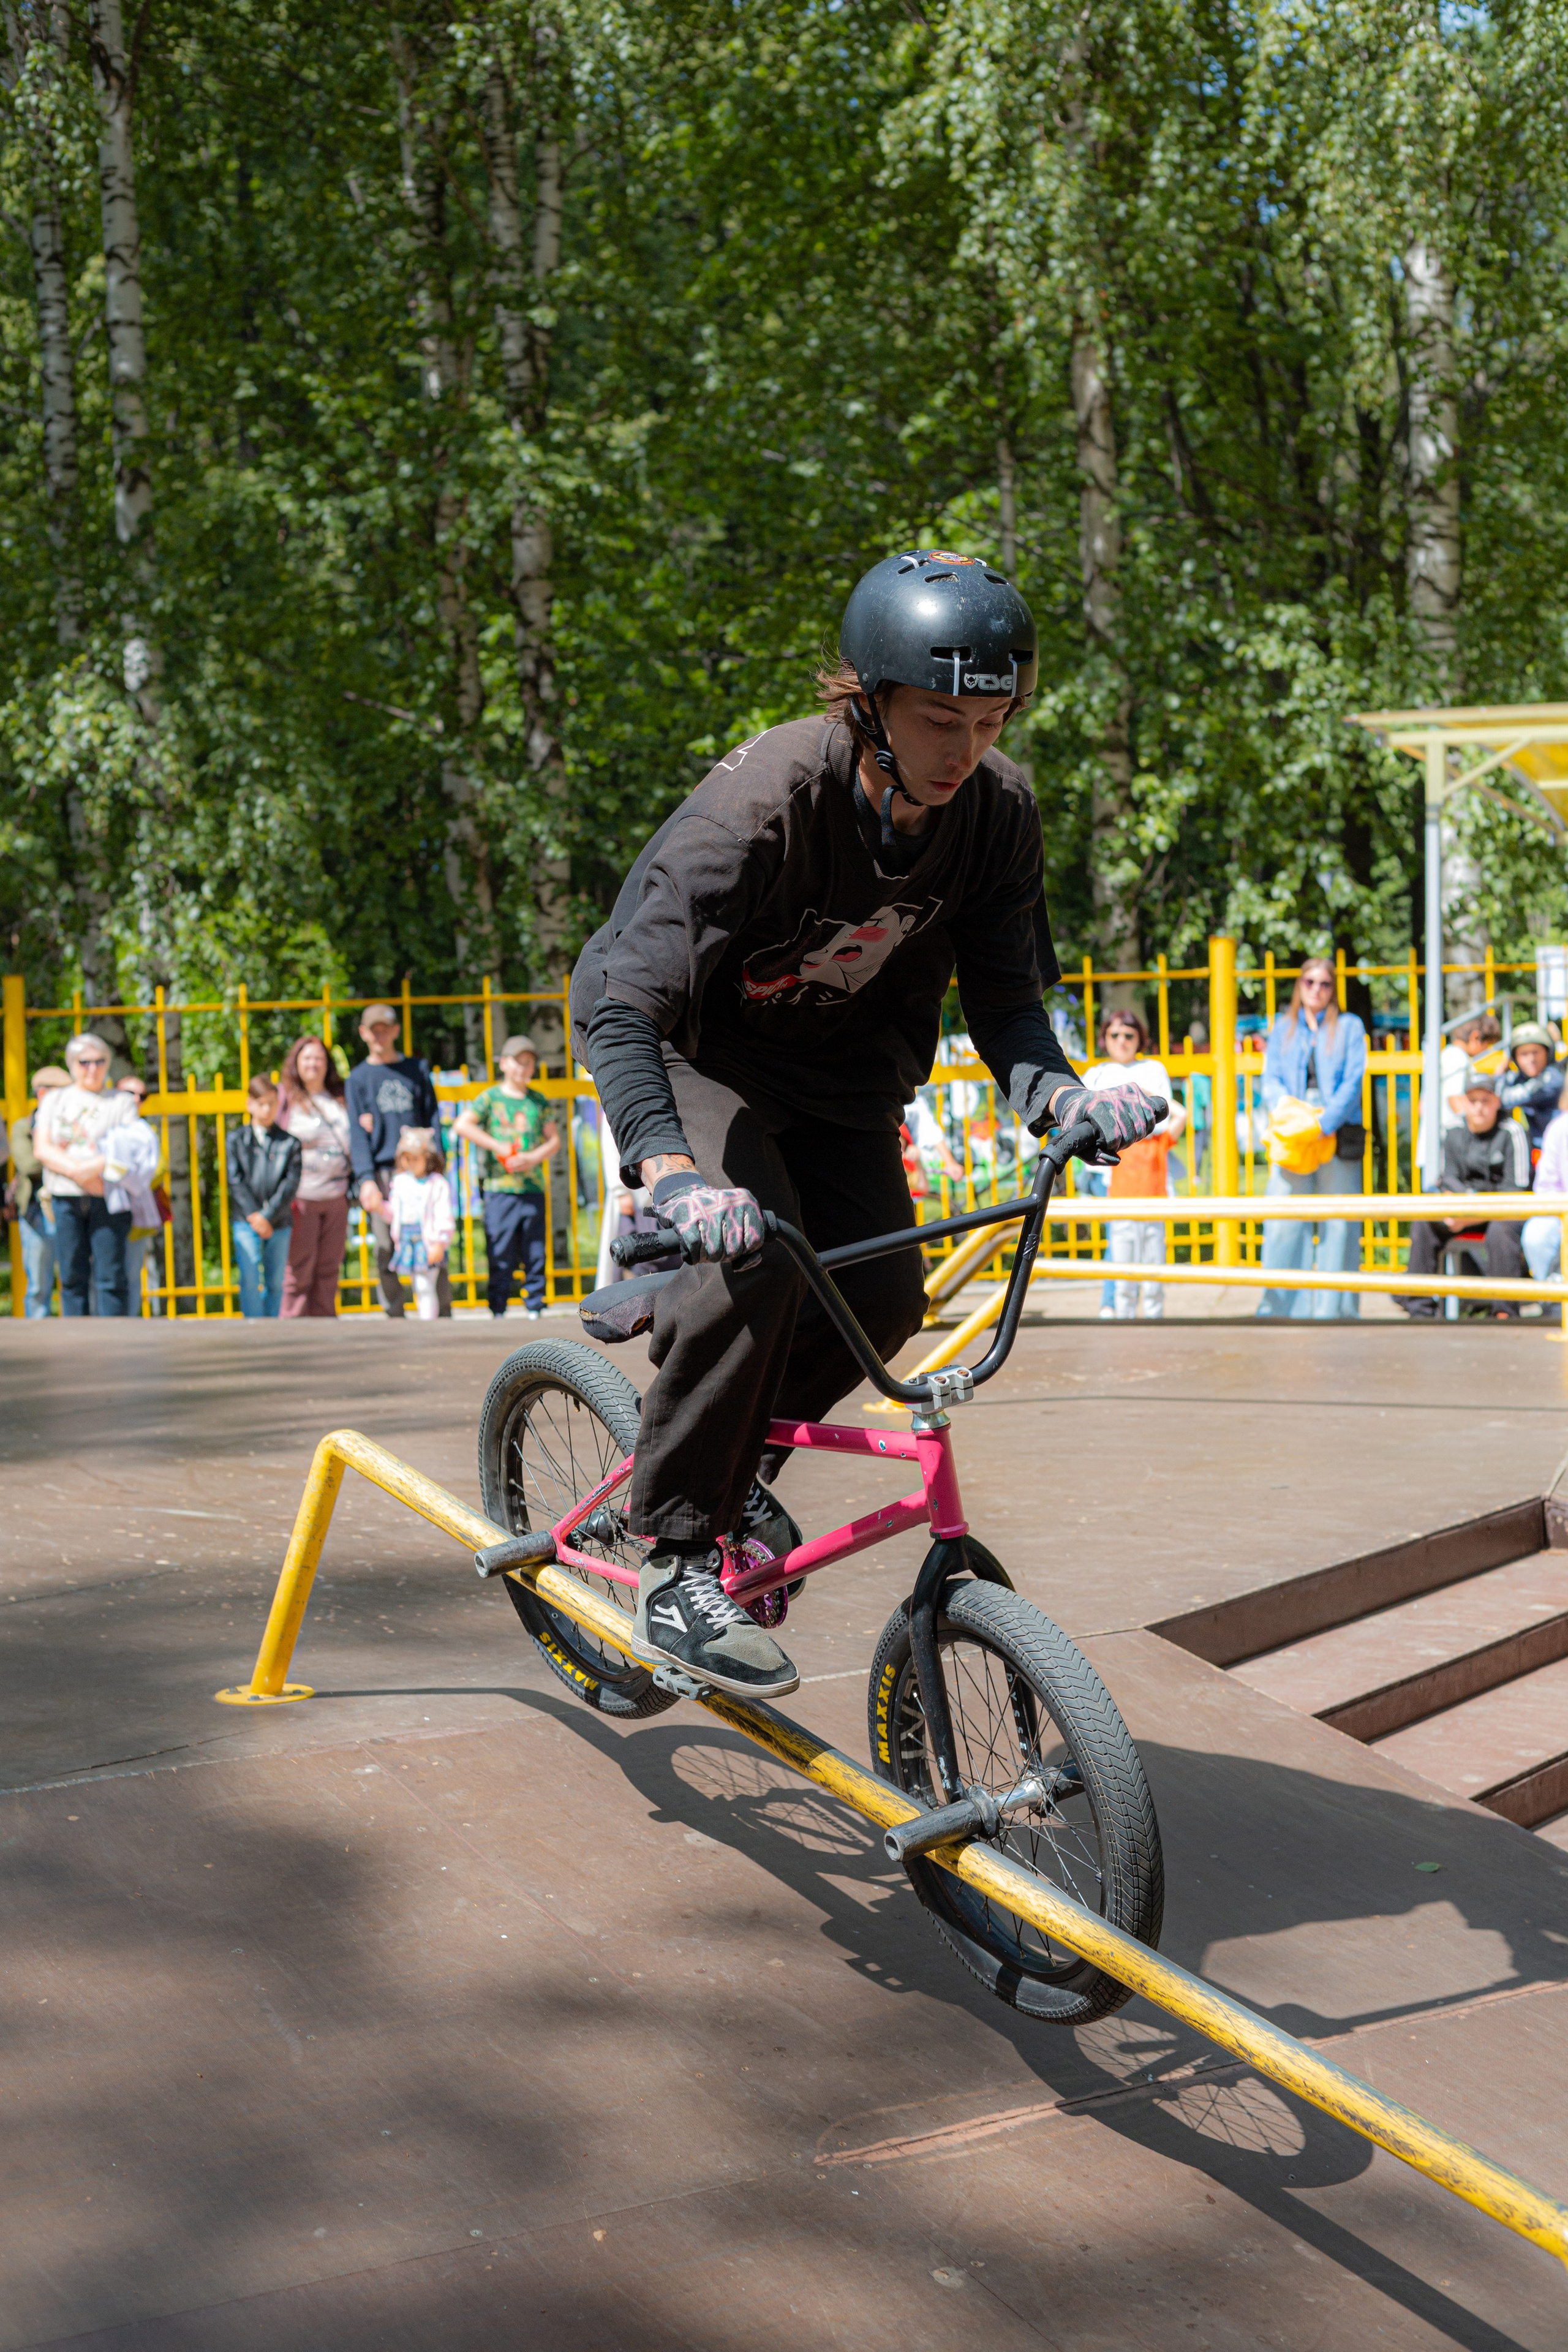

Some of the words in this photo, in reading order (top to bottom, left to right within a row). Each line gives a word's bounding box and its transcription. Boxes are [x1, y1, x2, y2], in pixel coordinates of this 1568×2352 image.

[978, 674, 1013, 690] TSG
[539, 1631, 599, 1691] MAXXIS
[876, 1663, 897, 1764] MAXXIS
